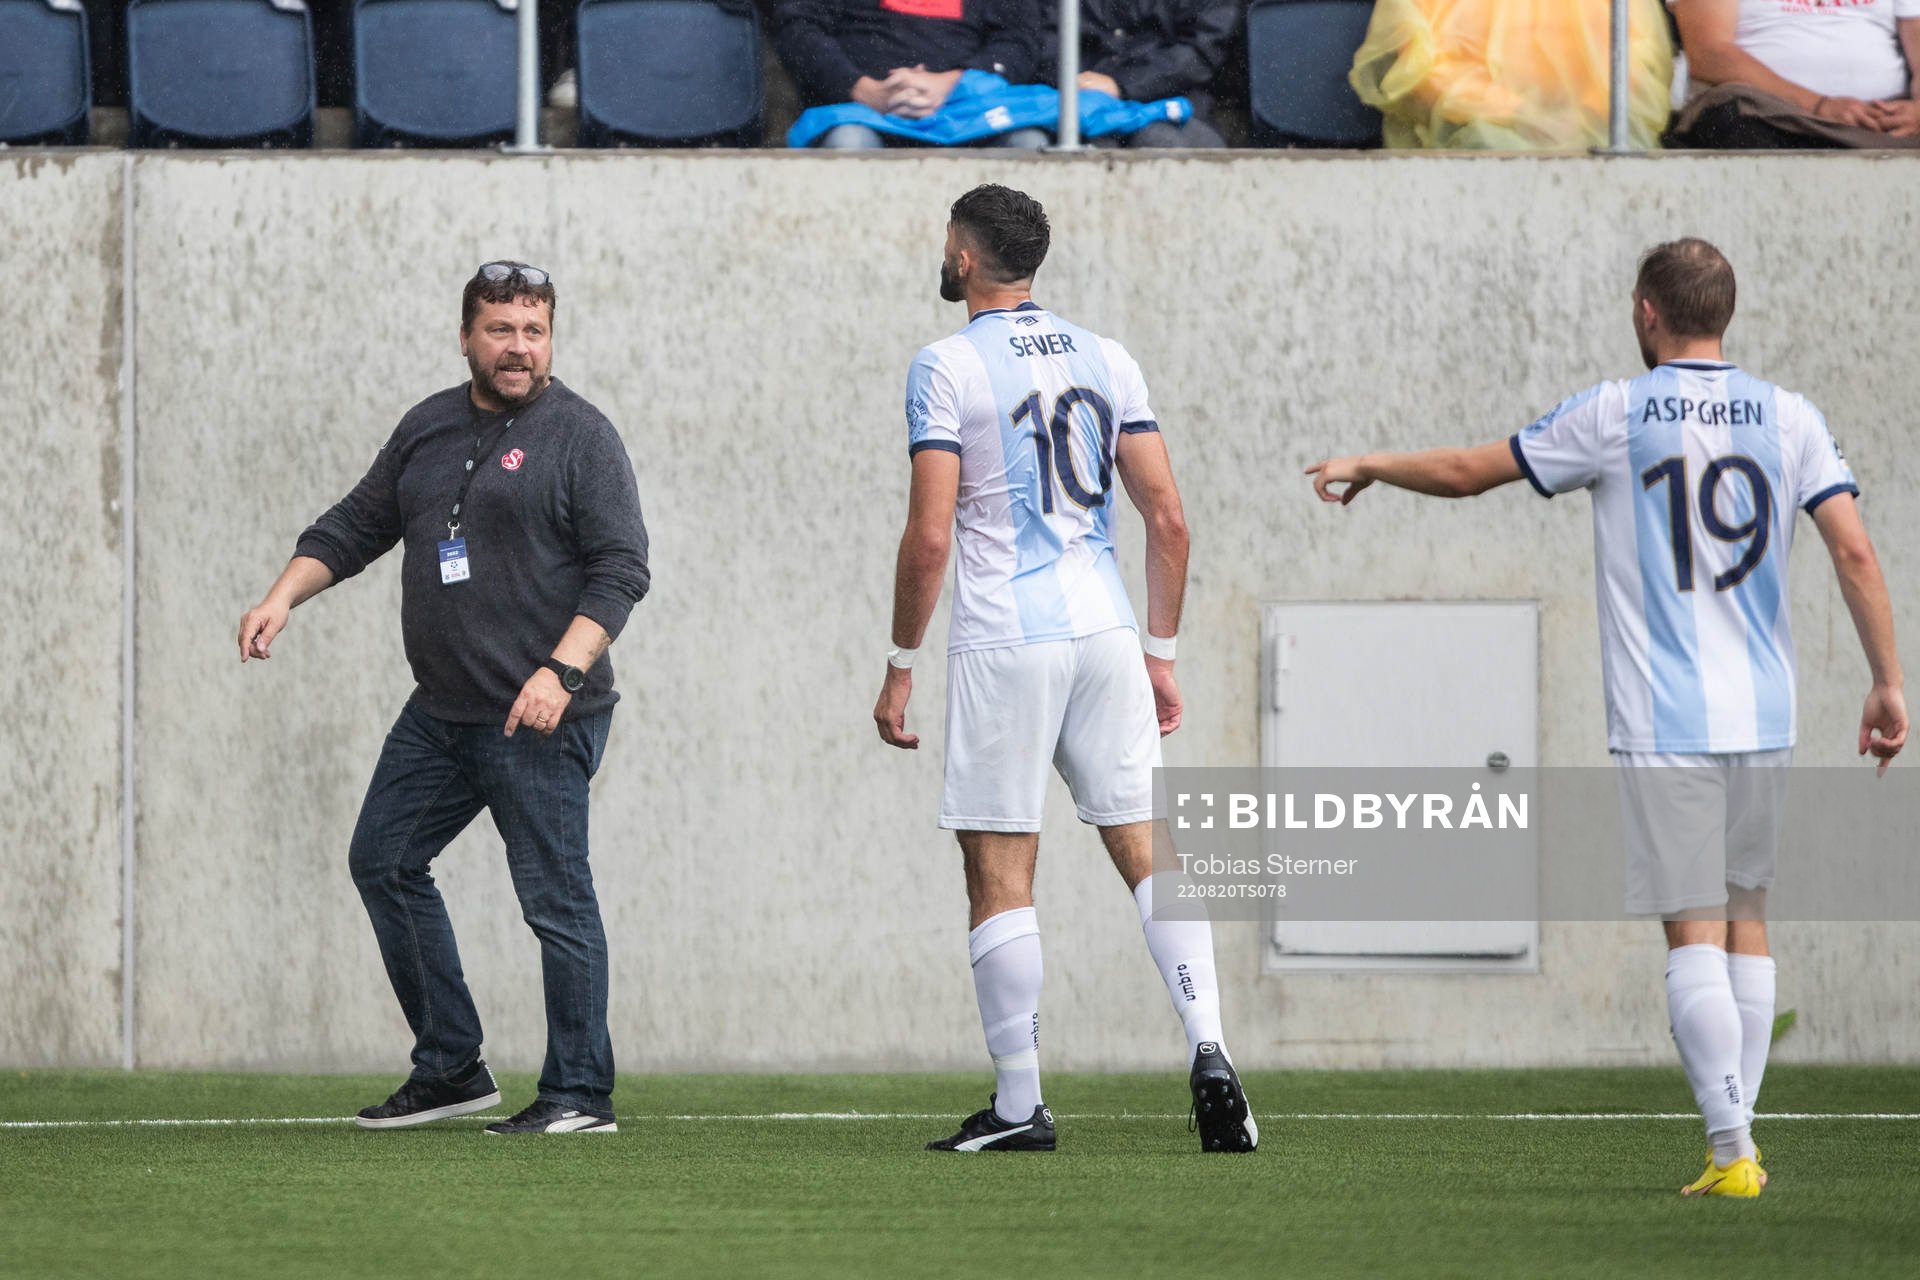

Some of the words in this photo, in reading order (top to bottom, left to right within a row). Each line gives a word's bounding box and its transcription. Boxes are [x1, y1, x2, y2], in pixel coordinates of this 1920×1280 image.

[1009, 333, 1078, 357] SEVER
[1642, 396, 1762, 426] ASPGREN
[1008, 385, 1114, 515] 10
[1640, 454, 1772, 592] 19
[1177, 963, 1196, 1001] umbro
